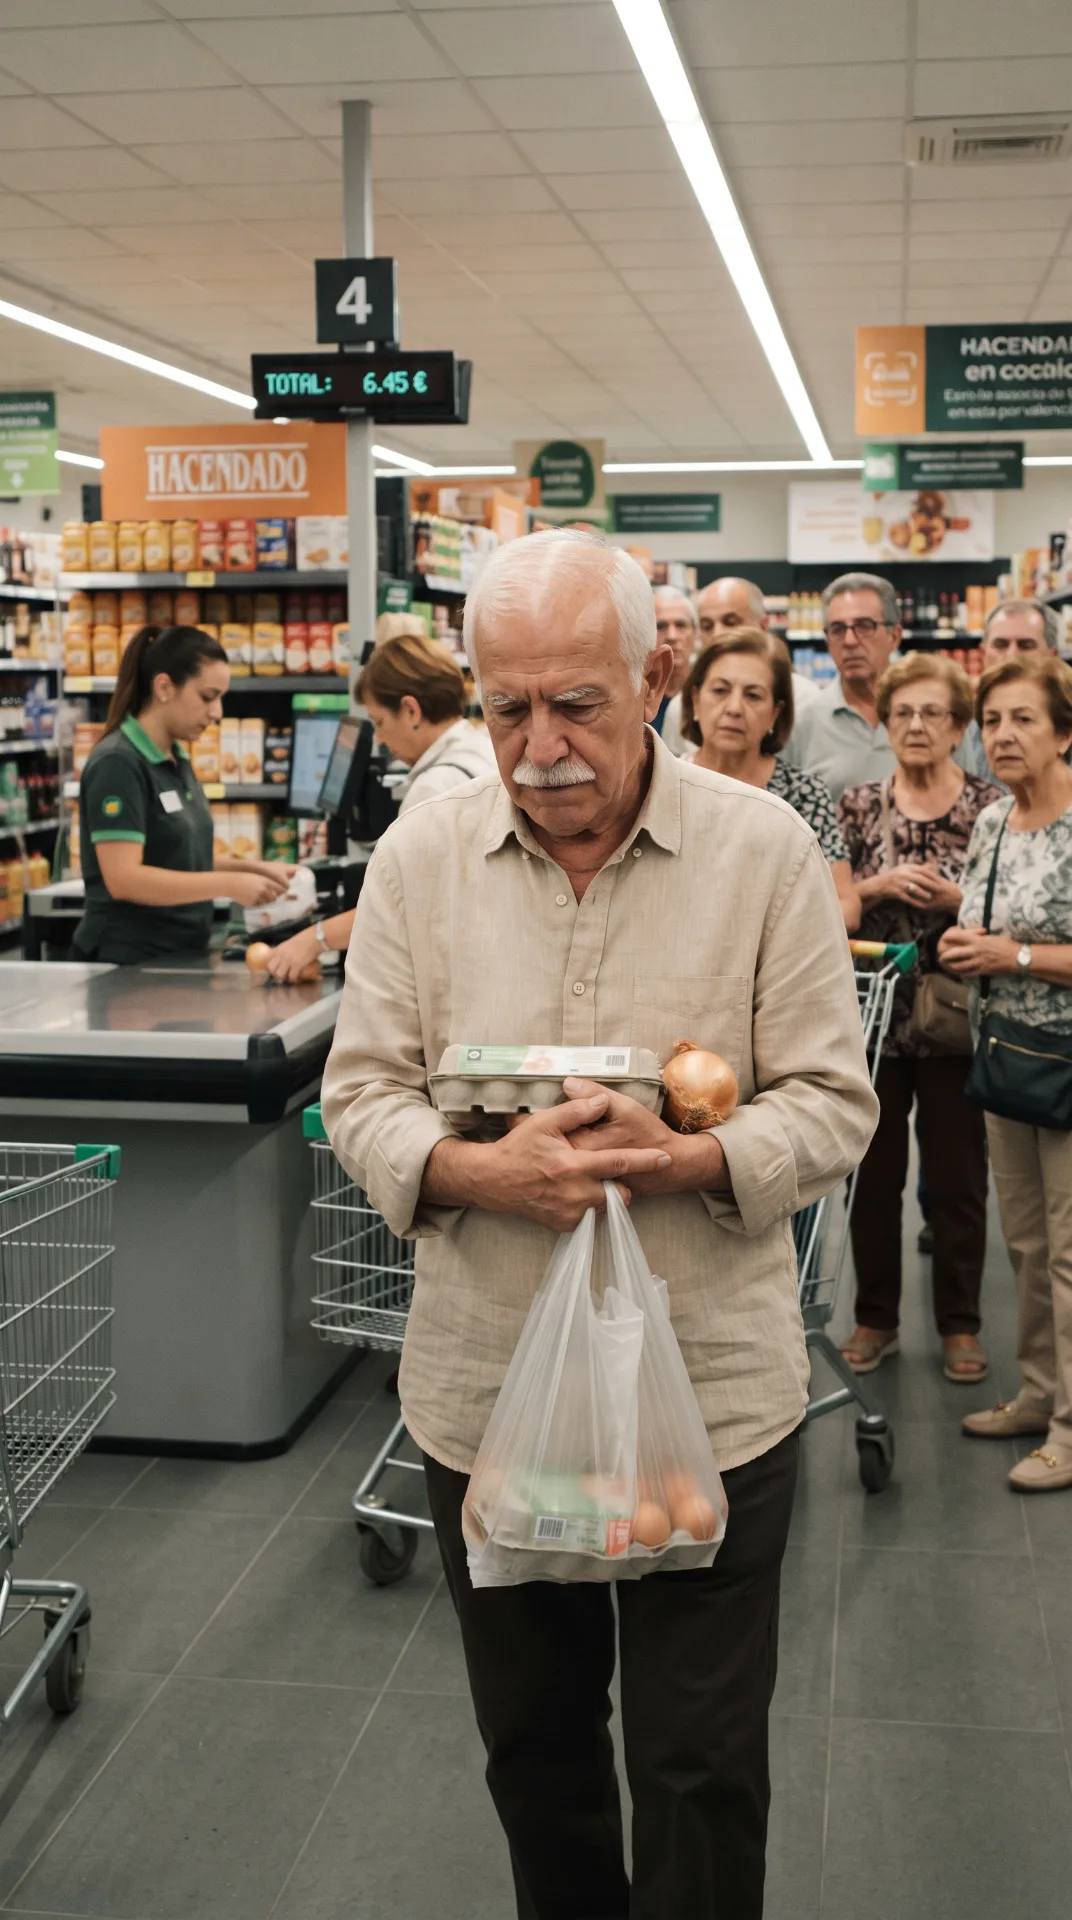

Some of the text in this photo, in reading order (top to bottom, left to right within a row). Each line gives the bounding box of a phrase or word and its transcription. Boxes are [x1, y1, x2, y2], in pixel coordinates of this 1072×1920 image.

[335, 276, 373, 325] 4
[960, 335, 1072, 357] HACENDA
[265, 372, 332, 396] TOTAL:
[964, 363, 997, 382] en
[148, 450, 307, 493] HACENDADO
